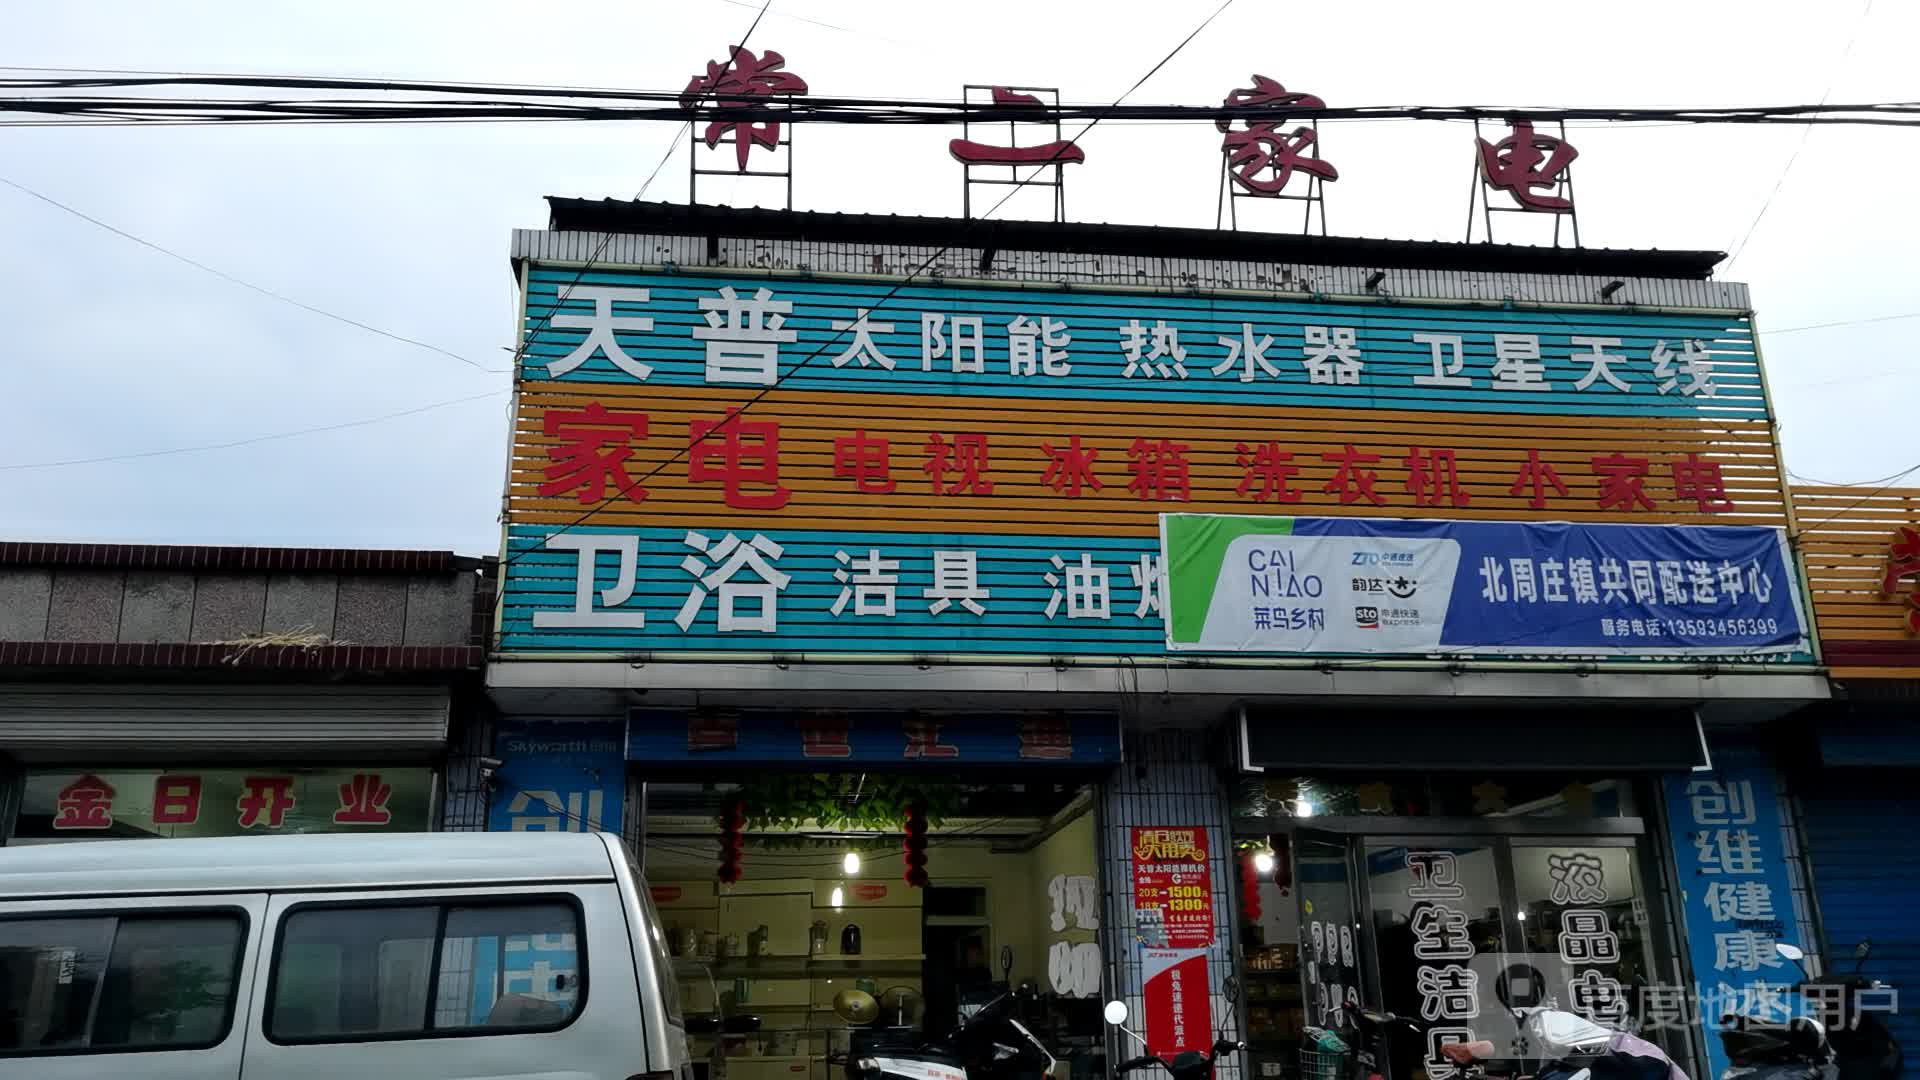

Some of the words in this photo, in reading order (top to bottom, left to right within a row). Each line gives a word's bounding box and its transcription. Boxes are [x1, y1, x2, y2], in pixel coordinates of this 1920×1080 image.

[830, 308, 1073, 377] 太阳能
[1119, 319, 1365, 387] 热水器
[1412, 331, 1717, 398] 卫星天线
[833, 429, 993, 497] 电视
[1039, 435, 1192, 502] 冰箱
[1234, 440, 1470, 508] 洗衣机
[1510, 448, 1735, 514] 小家电
[1249, 549, 1295, 572] CAI
[829, 549, 990, 619] 洁具
[1352, 578, 1384, 592] 韵达
[1479, 556, 1772, 606] 北周庄镇共同配送中心
[1254, 607, 1325, 631] 菜鸟乡村
[1356, 609, 1377, 619] sto
